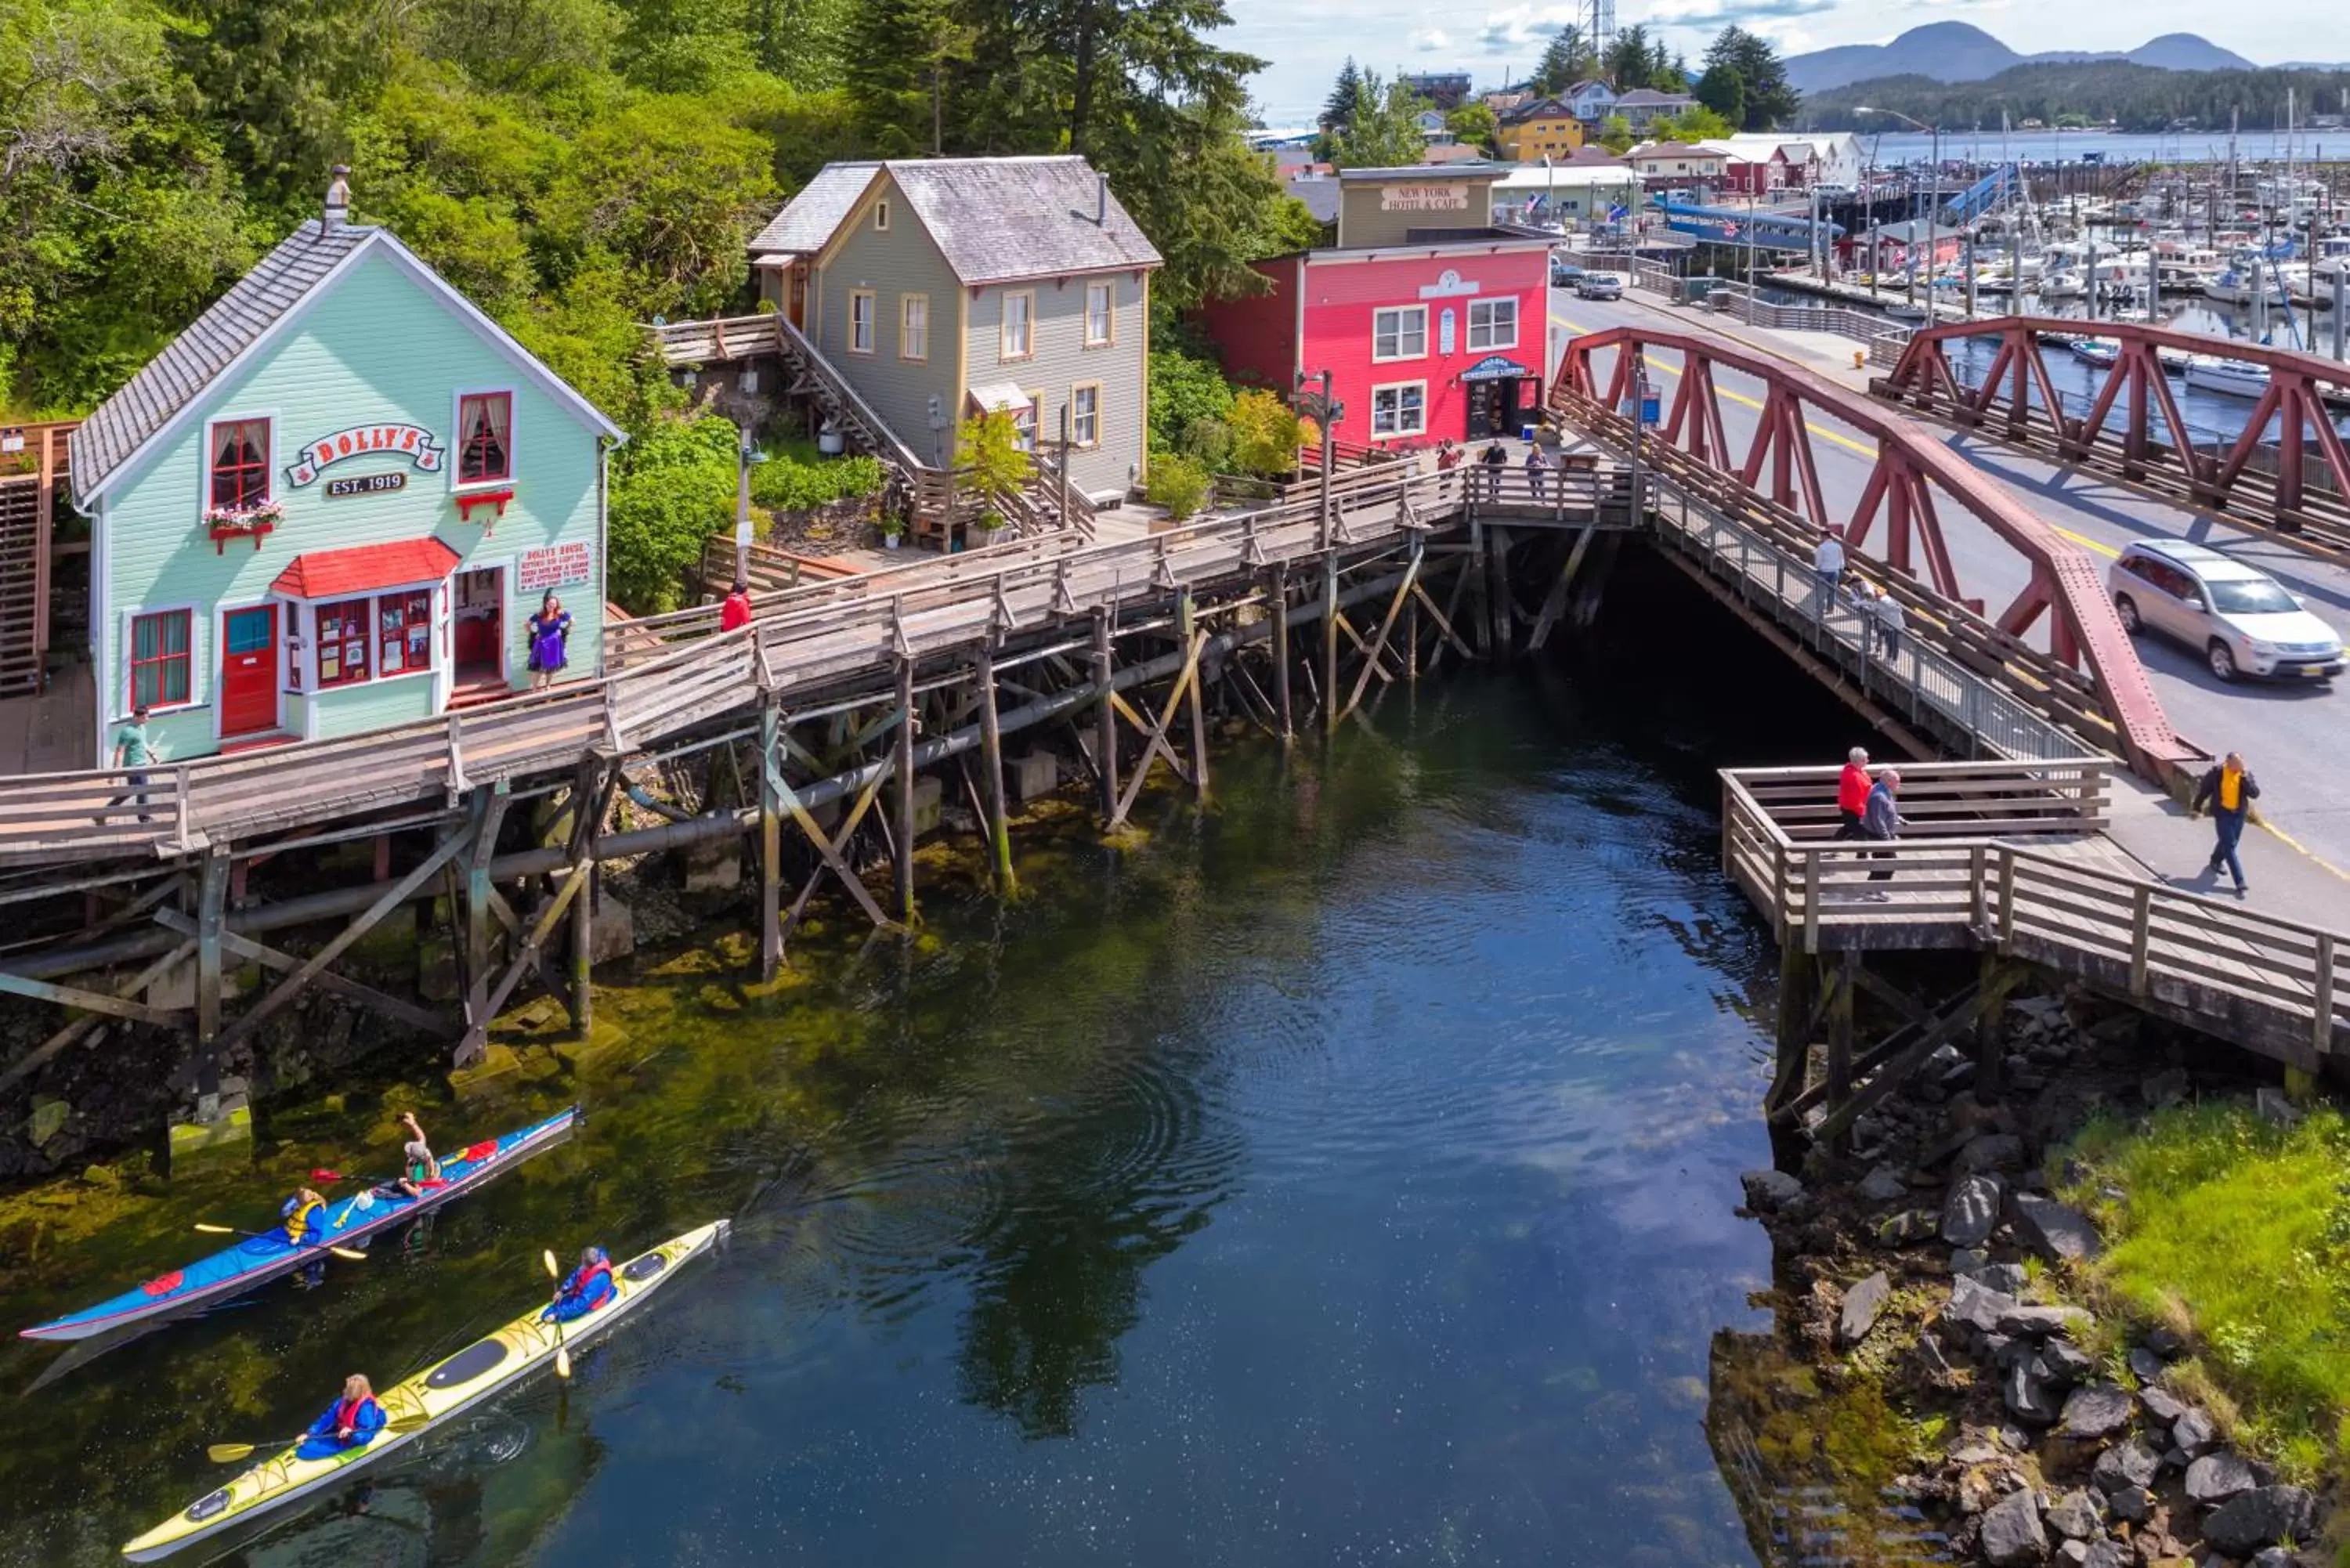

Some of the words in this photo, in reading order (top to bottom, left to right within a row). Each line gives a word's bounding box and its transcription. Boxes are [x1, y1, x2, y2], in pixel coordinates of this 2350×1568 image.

[1399, 187, 1419, 198] NEW
[1424, 187, 1451, 197] YORK
[316, 428, 418, 463] DOLLY'S
[331, 480, 363, 495] EST.
[369, 475, 401, 490] 1919
[560, 543, 584, 555] HOUSE
